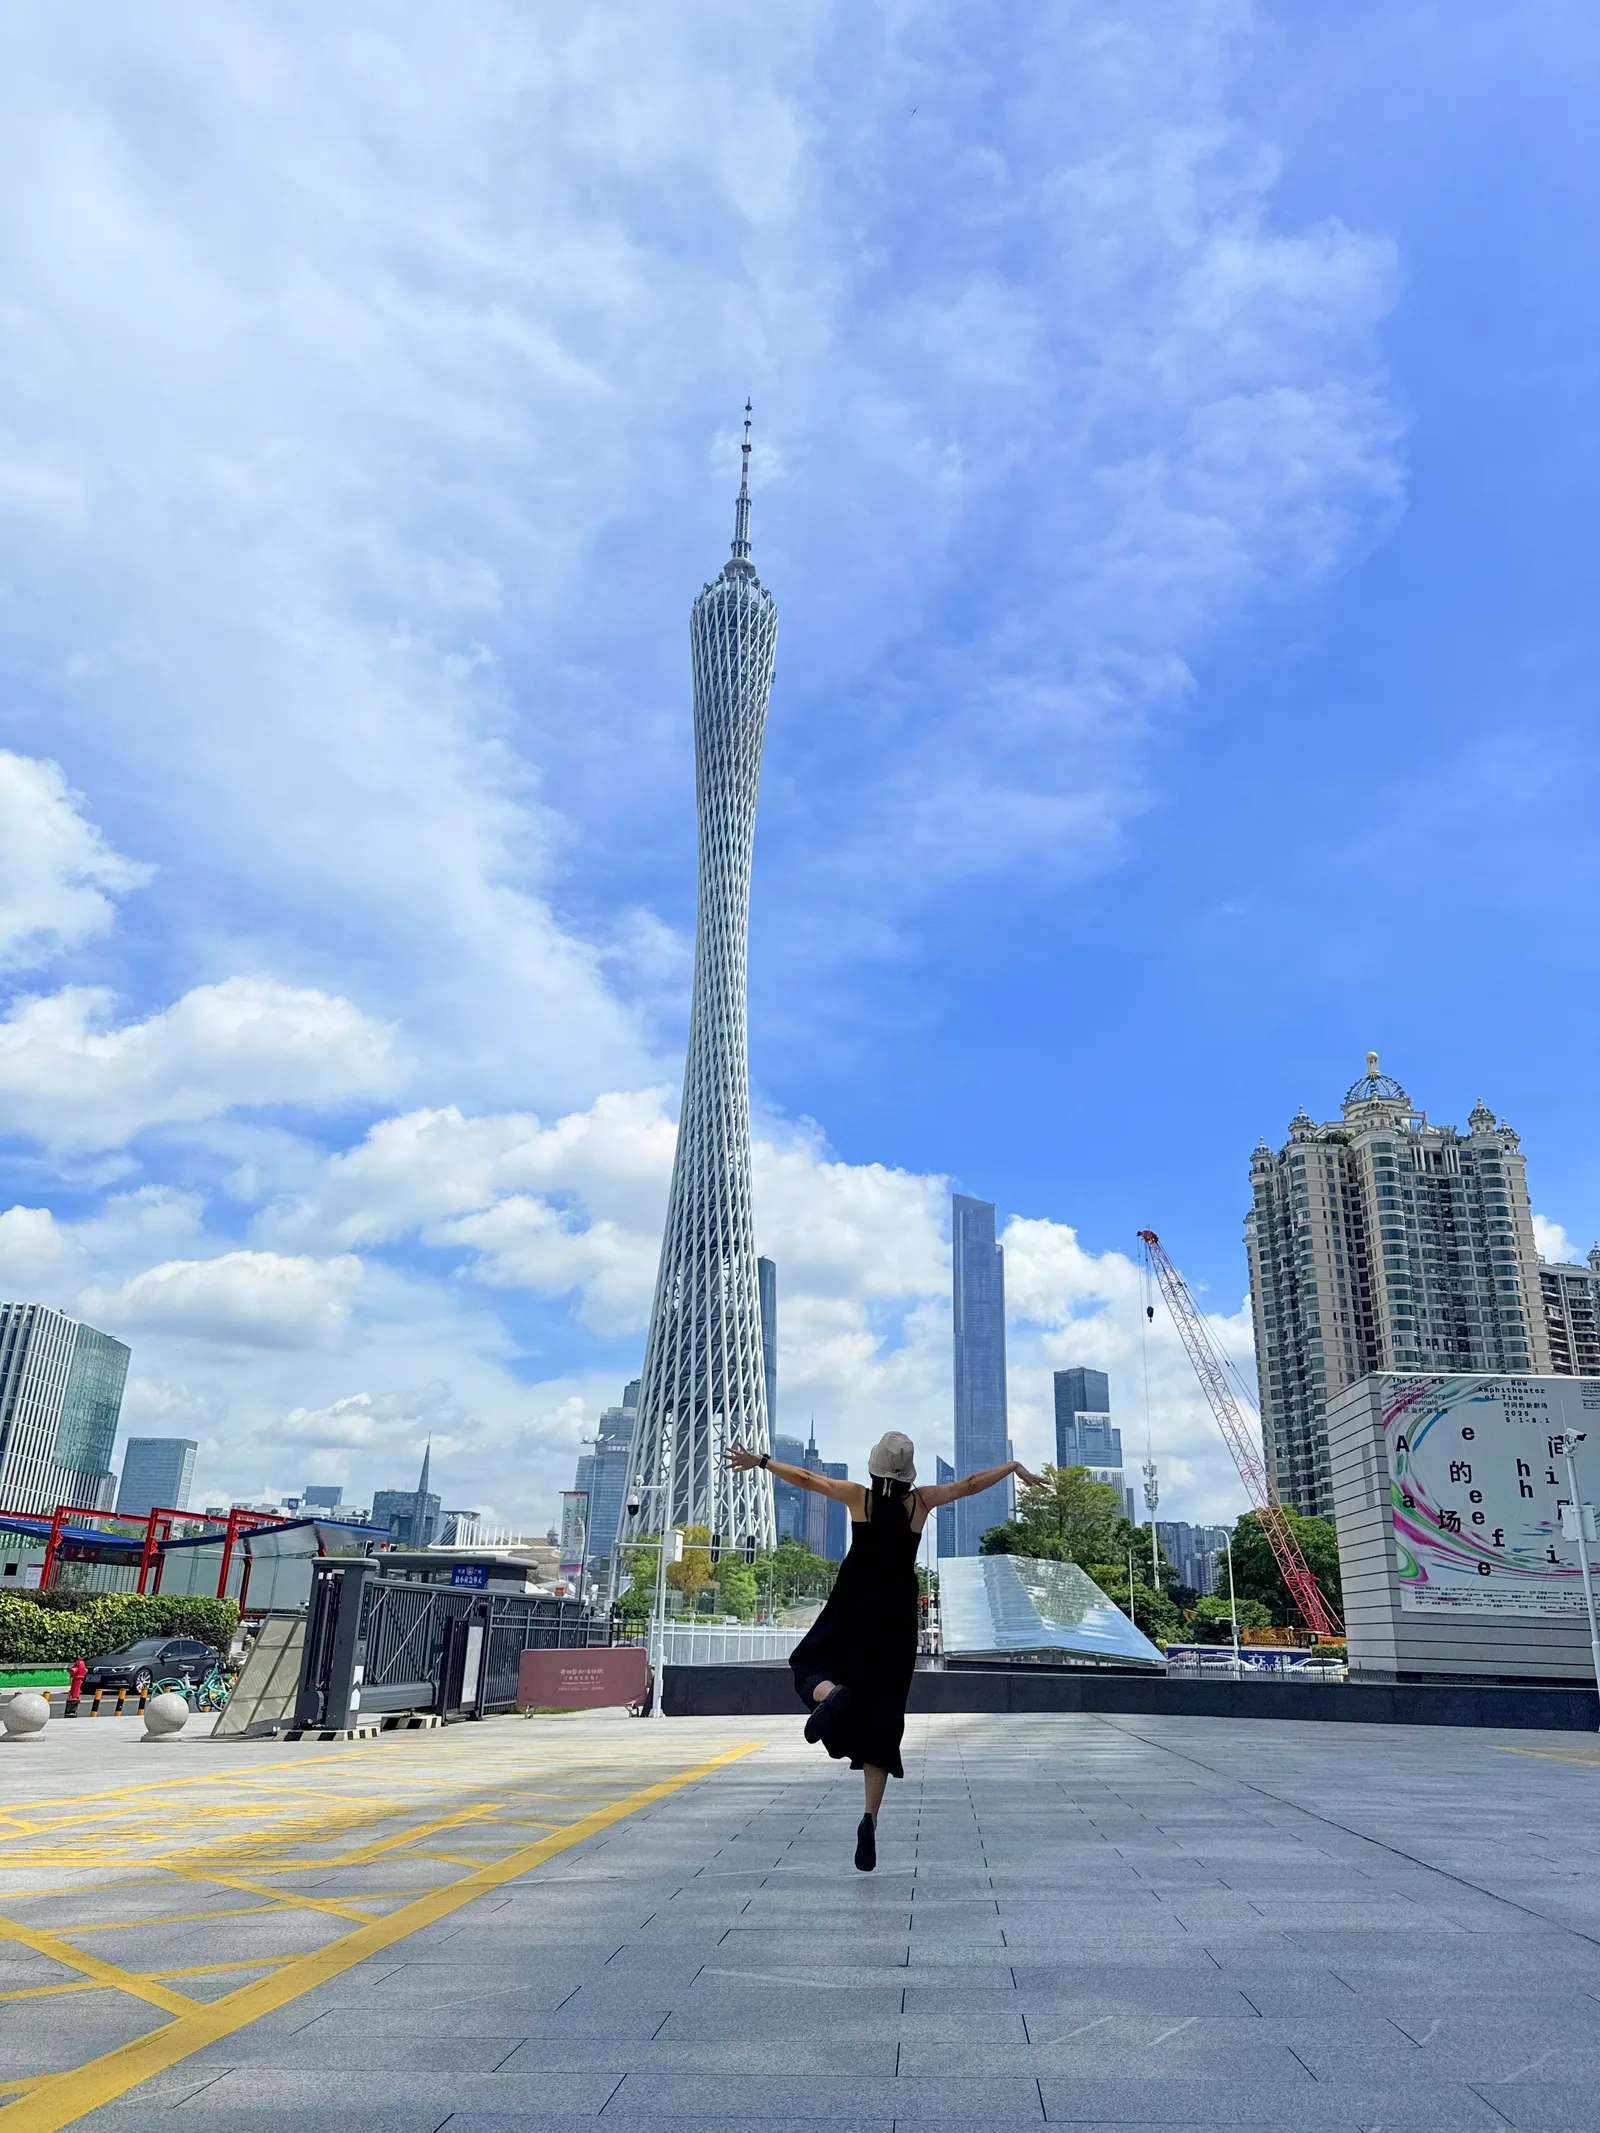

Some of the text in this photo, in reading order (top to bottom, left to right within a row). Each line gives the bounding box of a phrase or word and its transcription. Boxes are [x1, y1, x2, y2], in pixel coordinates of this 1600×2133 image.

[1478, 1386, 1546, 1394] Amphitheater
[1461, 1427, 1475, 1441] e
[1395, 1435, 1410, 1452] A
[1449, 1460, 1472, 1484] 的
[1516, 1459, 1531, 1476] h
[1545, 1466, 1559, 1484] i
[1469, 1489, 1483, 1503] e
[1519, 1480, 1534, 1498] h
[1402, 1494, 1415, 1509] a
[1437, 1509, 1461, 1533] 场
[1471, 1510, 1485, 1525] e
[1492, 1528, 1505, 1547] f
[1546, 1545, 1560, 1564] i
[1477, 1561, 1491, 1576] e
